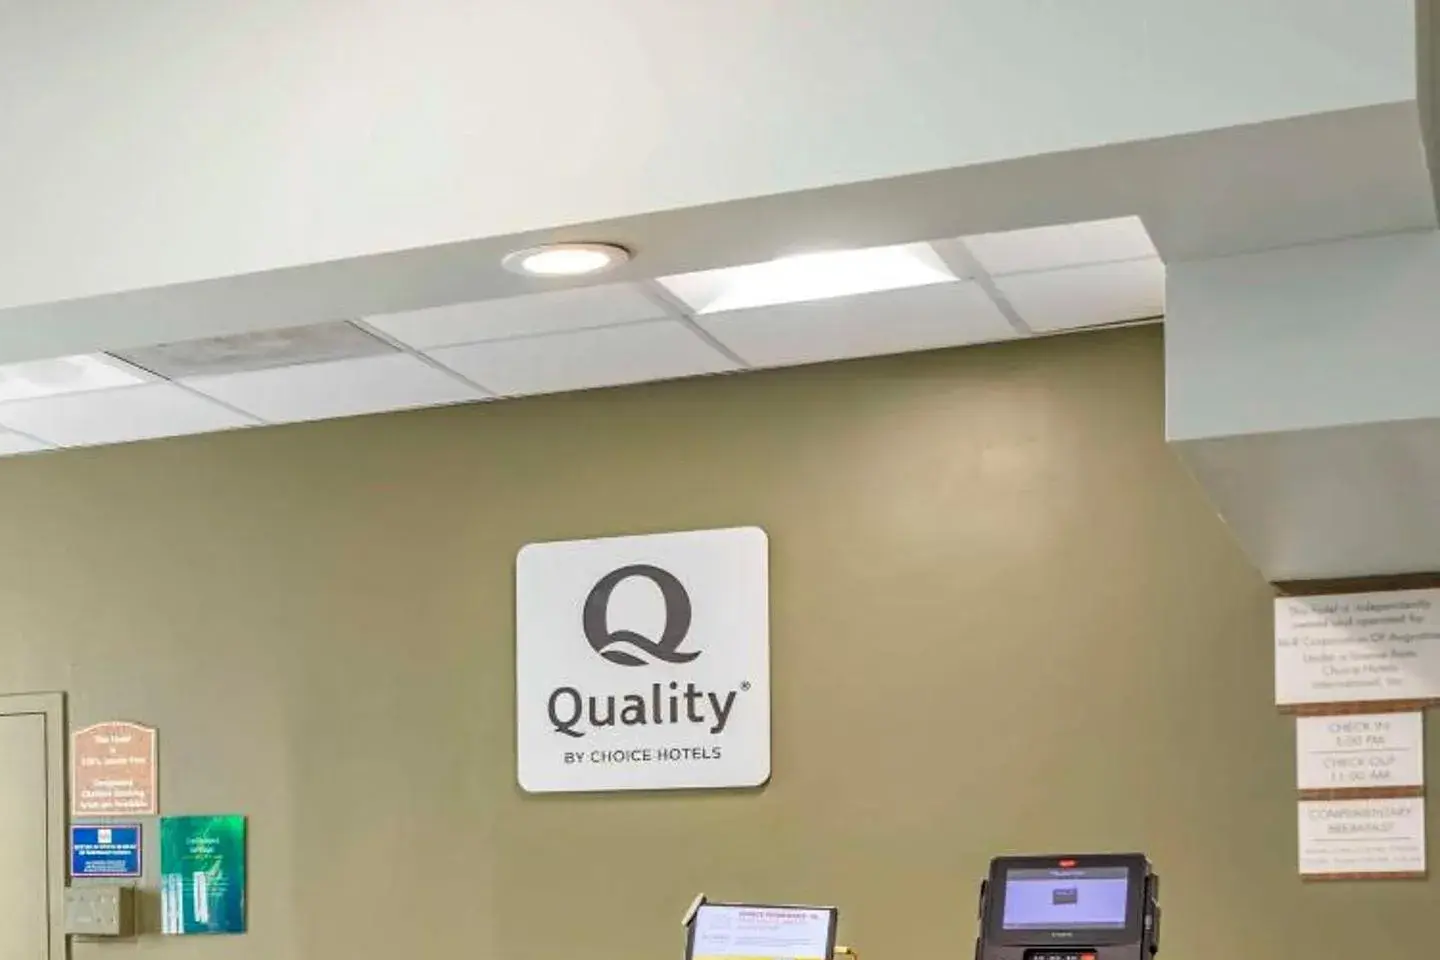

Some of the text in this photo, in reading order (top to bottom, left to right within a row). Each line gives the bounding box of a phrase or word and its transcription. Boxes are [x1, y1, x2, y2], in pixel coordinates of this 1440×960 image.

[583, 564, 702, 667] Q
[548, 681, 737, 738] Quality
[564, 747, 722, 763] BY CHOICE HOTELS
